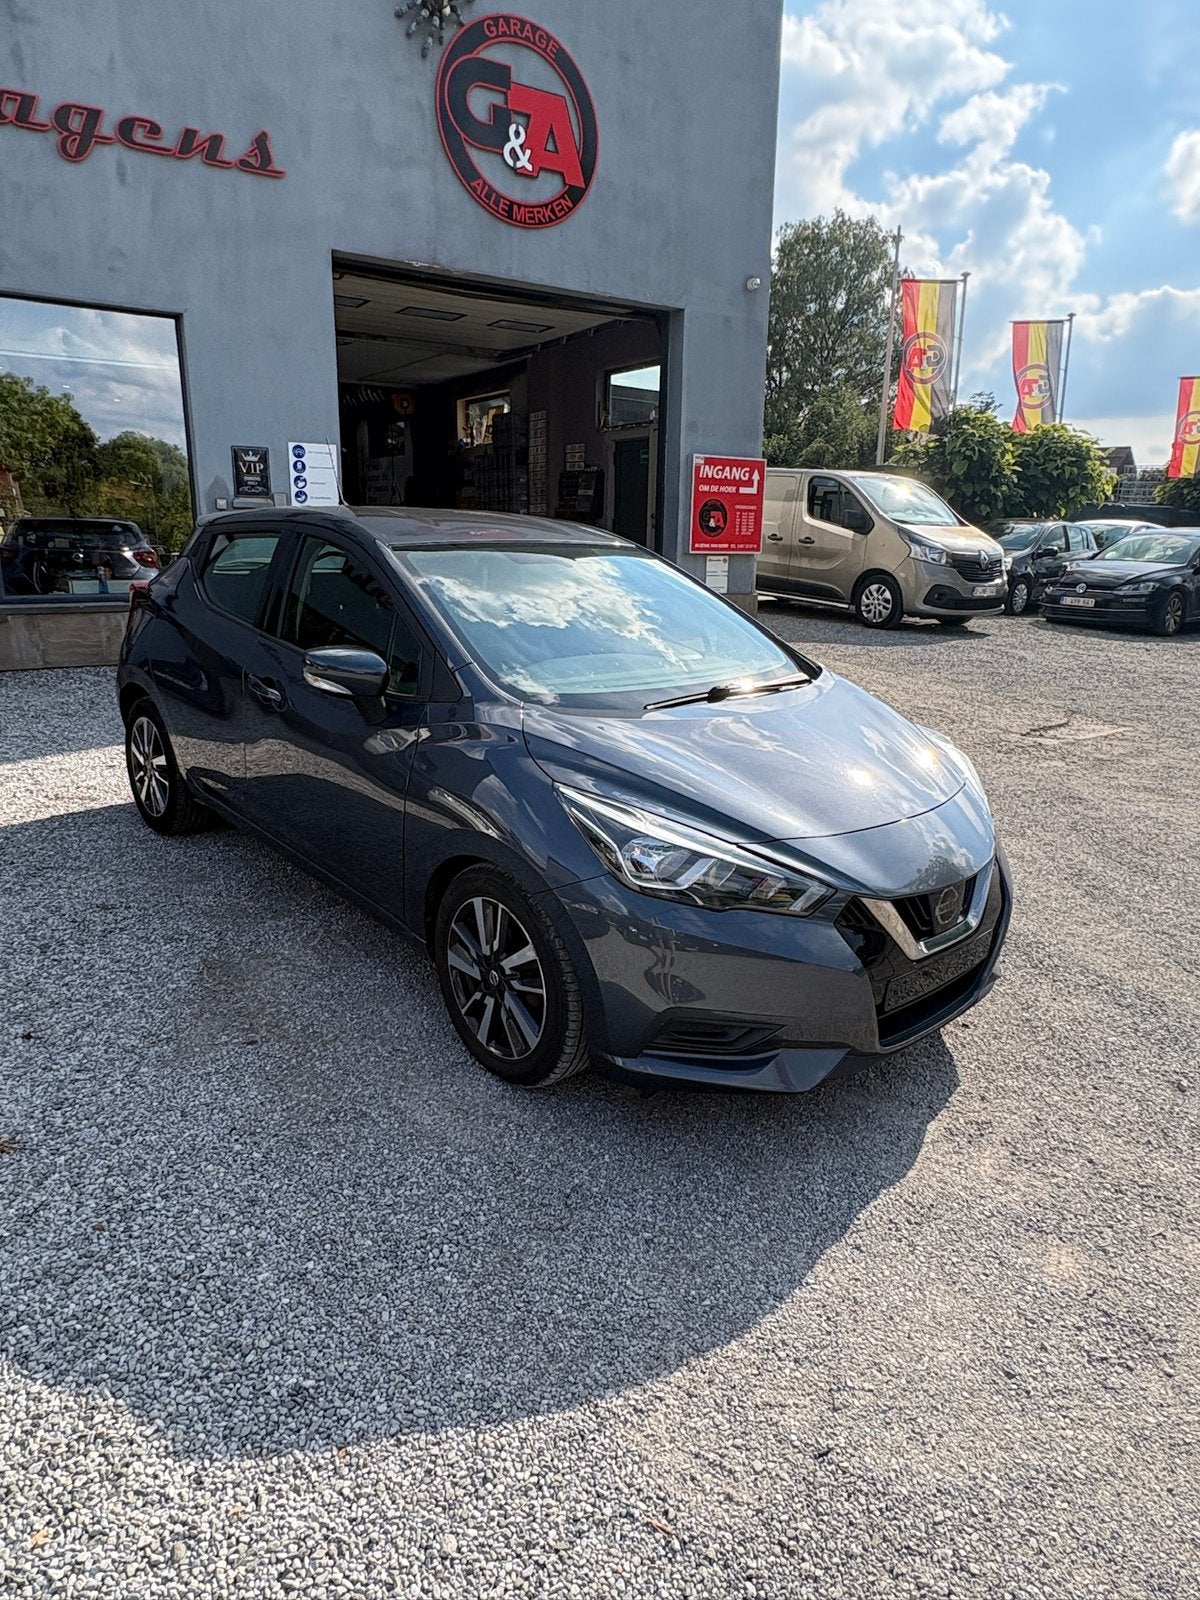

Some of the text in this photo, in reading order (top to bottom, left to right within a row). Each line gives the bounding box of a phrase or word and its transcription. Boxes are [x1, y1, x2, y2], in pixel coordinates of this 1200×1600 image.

[483, 17, 561, 59] GARAGE
[445, 54, 587, 189] G&A
[470, 177, 574, 225] ALLE MERKEN
[239, 461, 264, 474] VIP
[699, 465, 750, 480] INGANG
[698, 484, 737, 493] OM DE HOEK
